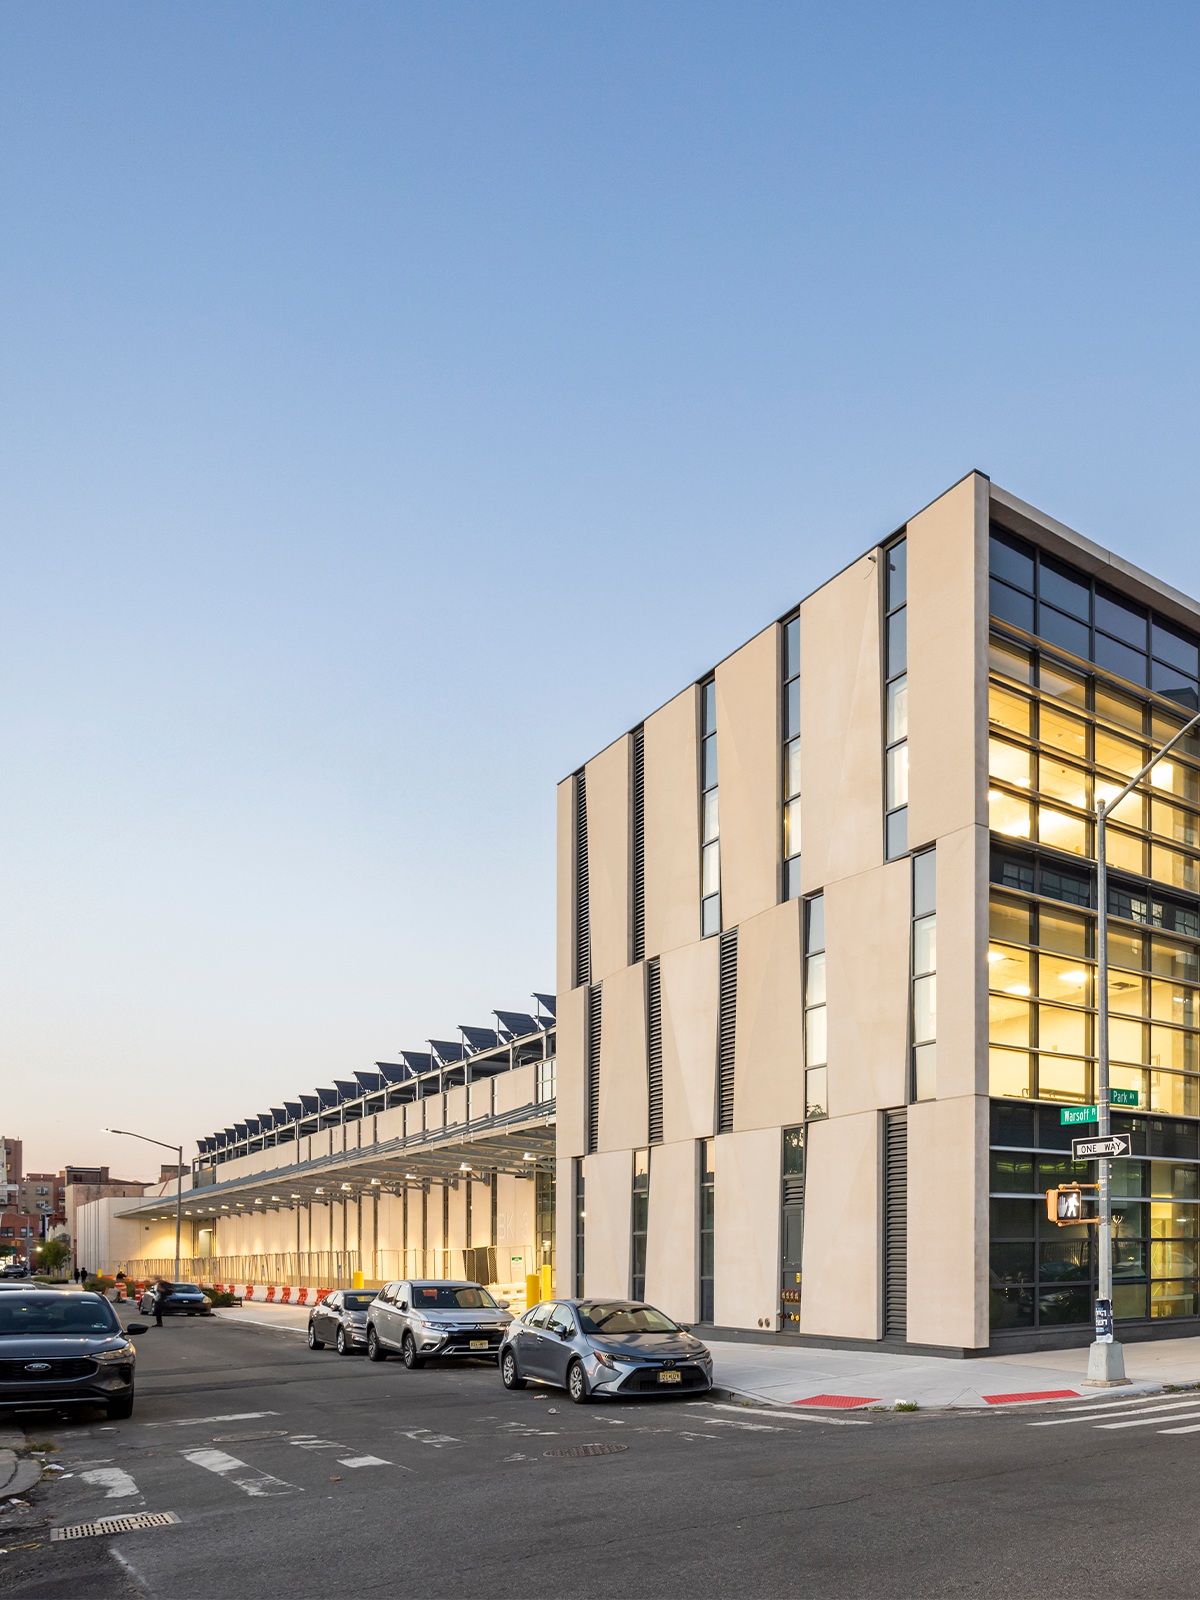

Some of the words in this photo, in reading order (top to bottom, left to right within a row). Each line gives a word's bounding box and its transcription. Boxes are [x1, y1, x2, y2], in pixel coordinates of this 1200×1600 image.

[1113, 1090, 1128, 1103] Park
[1064, 1109, 1089, 1122] Warsoff
[1081, 1144, 1097, 1154] ONE
[1104, 1141, 1121, 1151] WAY
[498, 1212, 514, 1240] BK
